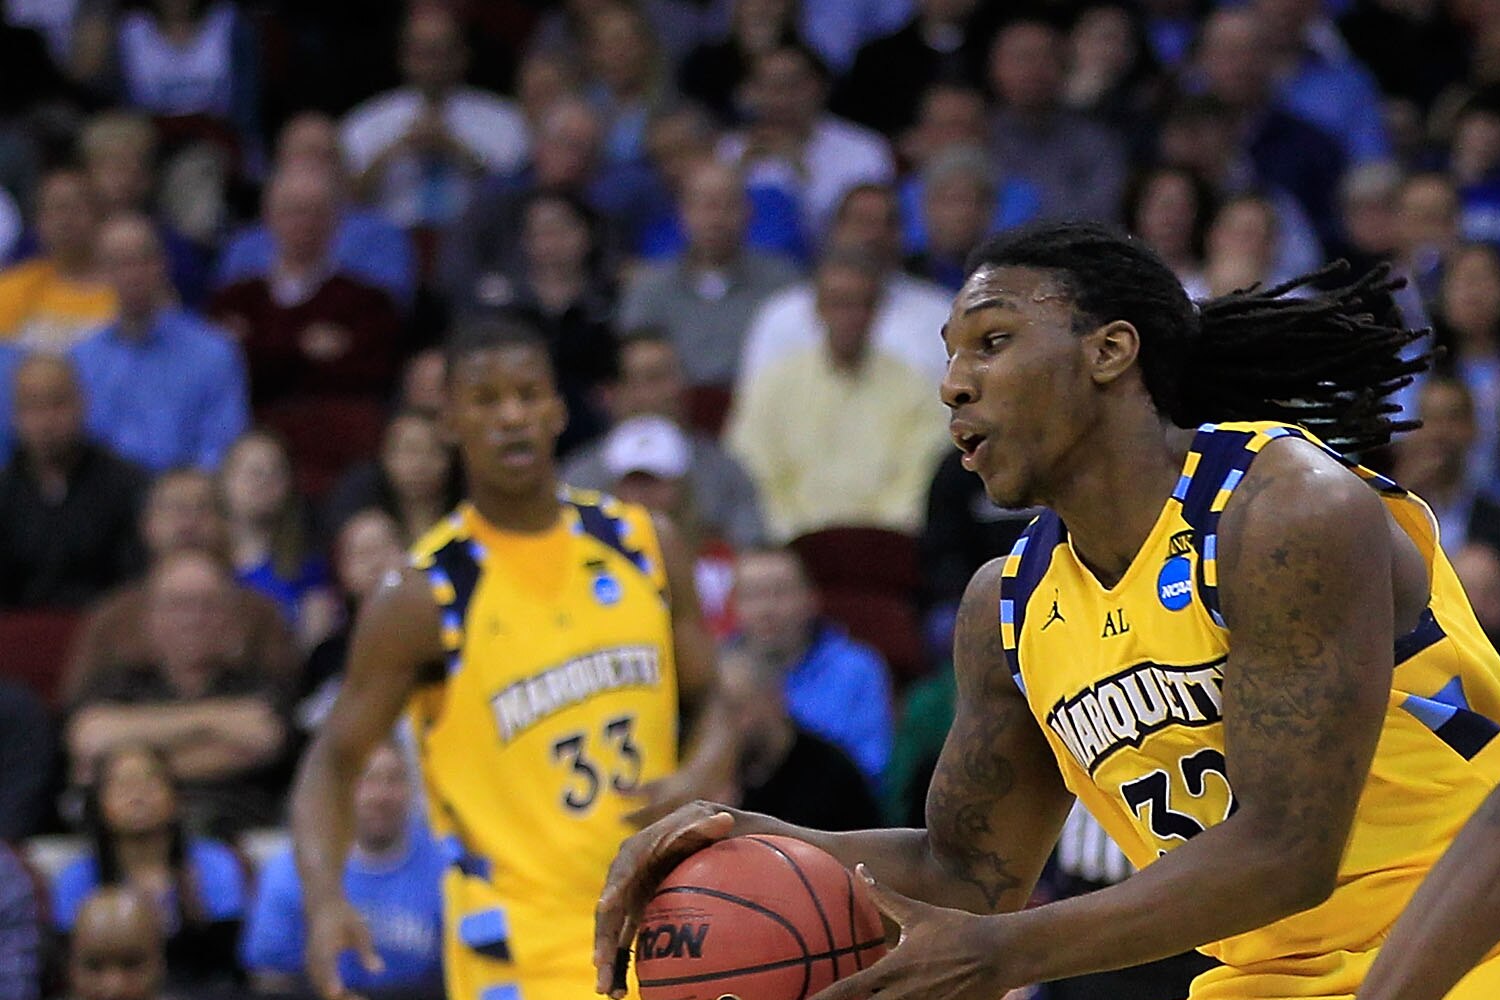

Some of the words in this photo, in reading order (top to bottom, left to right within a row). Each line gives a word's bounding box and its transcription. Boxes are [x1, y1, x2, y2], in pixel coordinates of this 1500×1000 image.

[1101, 607, 1130, 638] AL
[1047, 660, 1227, 774] MARQUETT
[551, 714, 643, 810] 33
[637, 923, 711, 962] NCA
